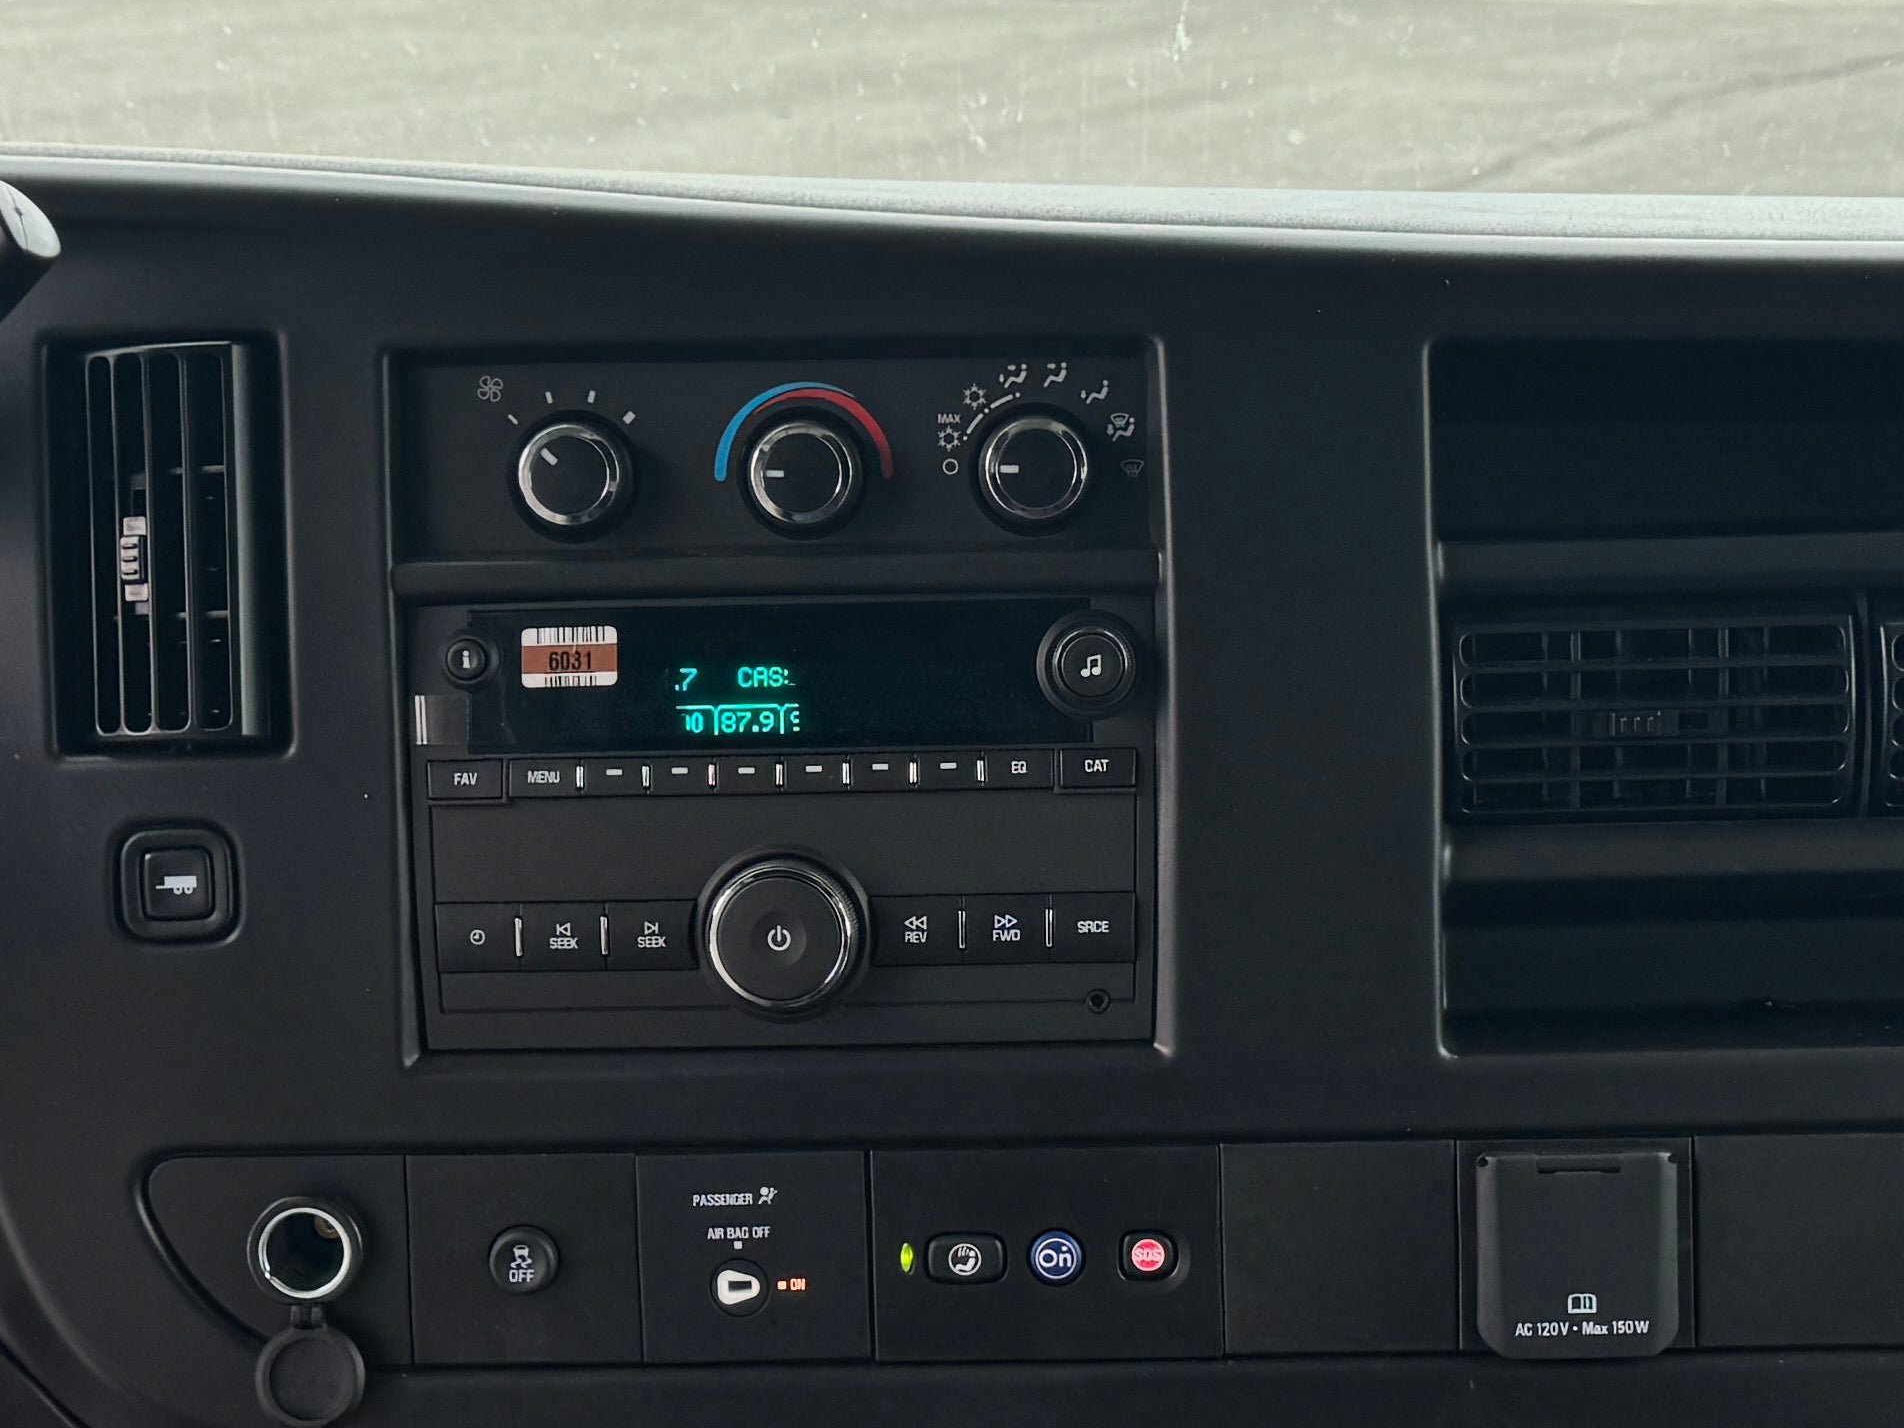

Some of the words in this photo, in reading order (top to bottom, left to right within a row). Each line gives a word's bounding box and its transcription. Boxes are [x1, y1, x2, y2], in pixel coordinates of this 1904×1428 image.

[937, 413, 961, 424] MAX
[548, 650, 592, 672] 6031
[720, 711, 775, 733] 87.9
[1011, 760, 1028, 774] EQ
[1084, 759, 1110, 773] CAT
[453, 772, 478, 786] FAV
[527, 770, 561, 784] MENU
[1076, 921, 1109, 933] SRCE
[637, 936, 666, 948] SEEK
[904, 931, 927, 943] REV
[992, 929, 1021, 942] FWD
[549, 937, 578, 950] SEEK
[692, 1193, 753, 1207] PASSENGER
[707, 1227, 724, 1240] AIR
[726, 1227, 749, 1239] BAG
[752, 1226, 771, 1238] OFF
[1133, 1247, 1163, 1263] SOS
[508, 1269, 534, 1282] OFF
[790, 1278, 806, 1290] ON
[1515, 1322, 1533, 1336] AC
[1582, 1321, 1609, 1335] Max
[1612, 1320, 1650, 1334] 150W
